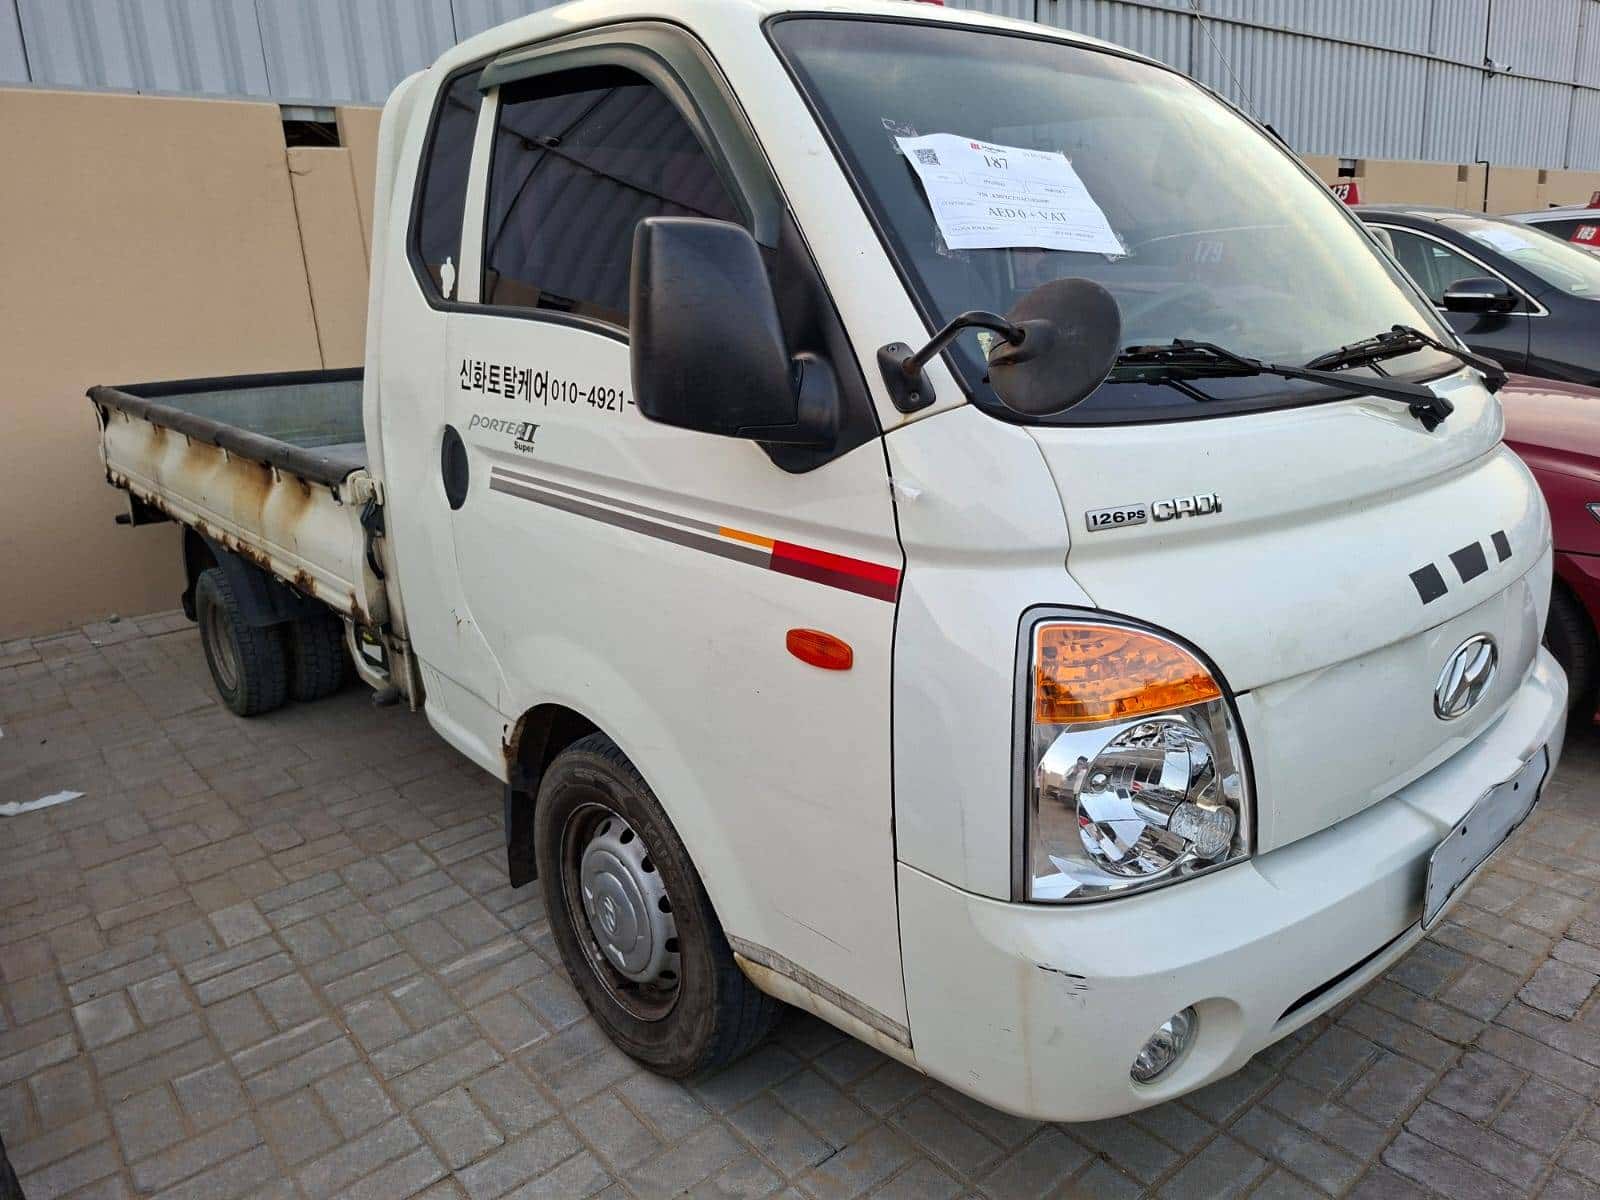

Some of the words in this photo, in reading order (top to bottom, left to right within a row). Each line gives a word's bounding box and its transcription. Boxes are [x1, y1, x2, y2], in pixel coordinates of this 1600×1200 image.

[983, 154, 1008, 169] 187
[988, 207, 1015, 220] AED
[460, 359, 549, 406] 신화토탈케어
[468, 414, 527, 437] PORTER
[514, 440, 534, 453] Super
